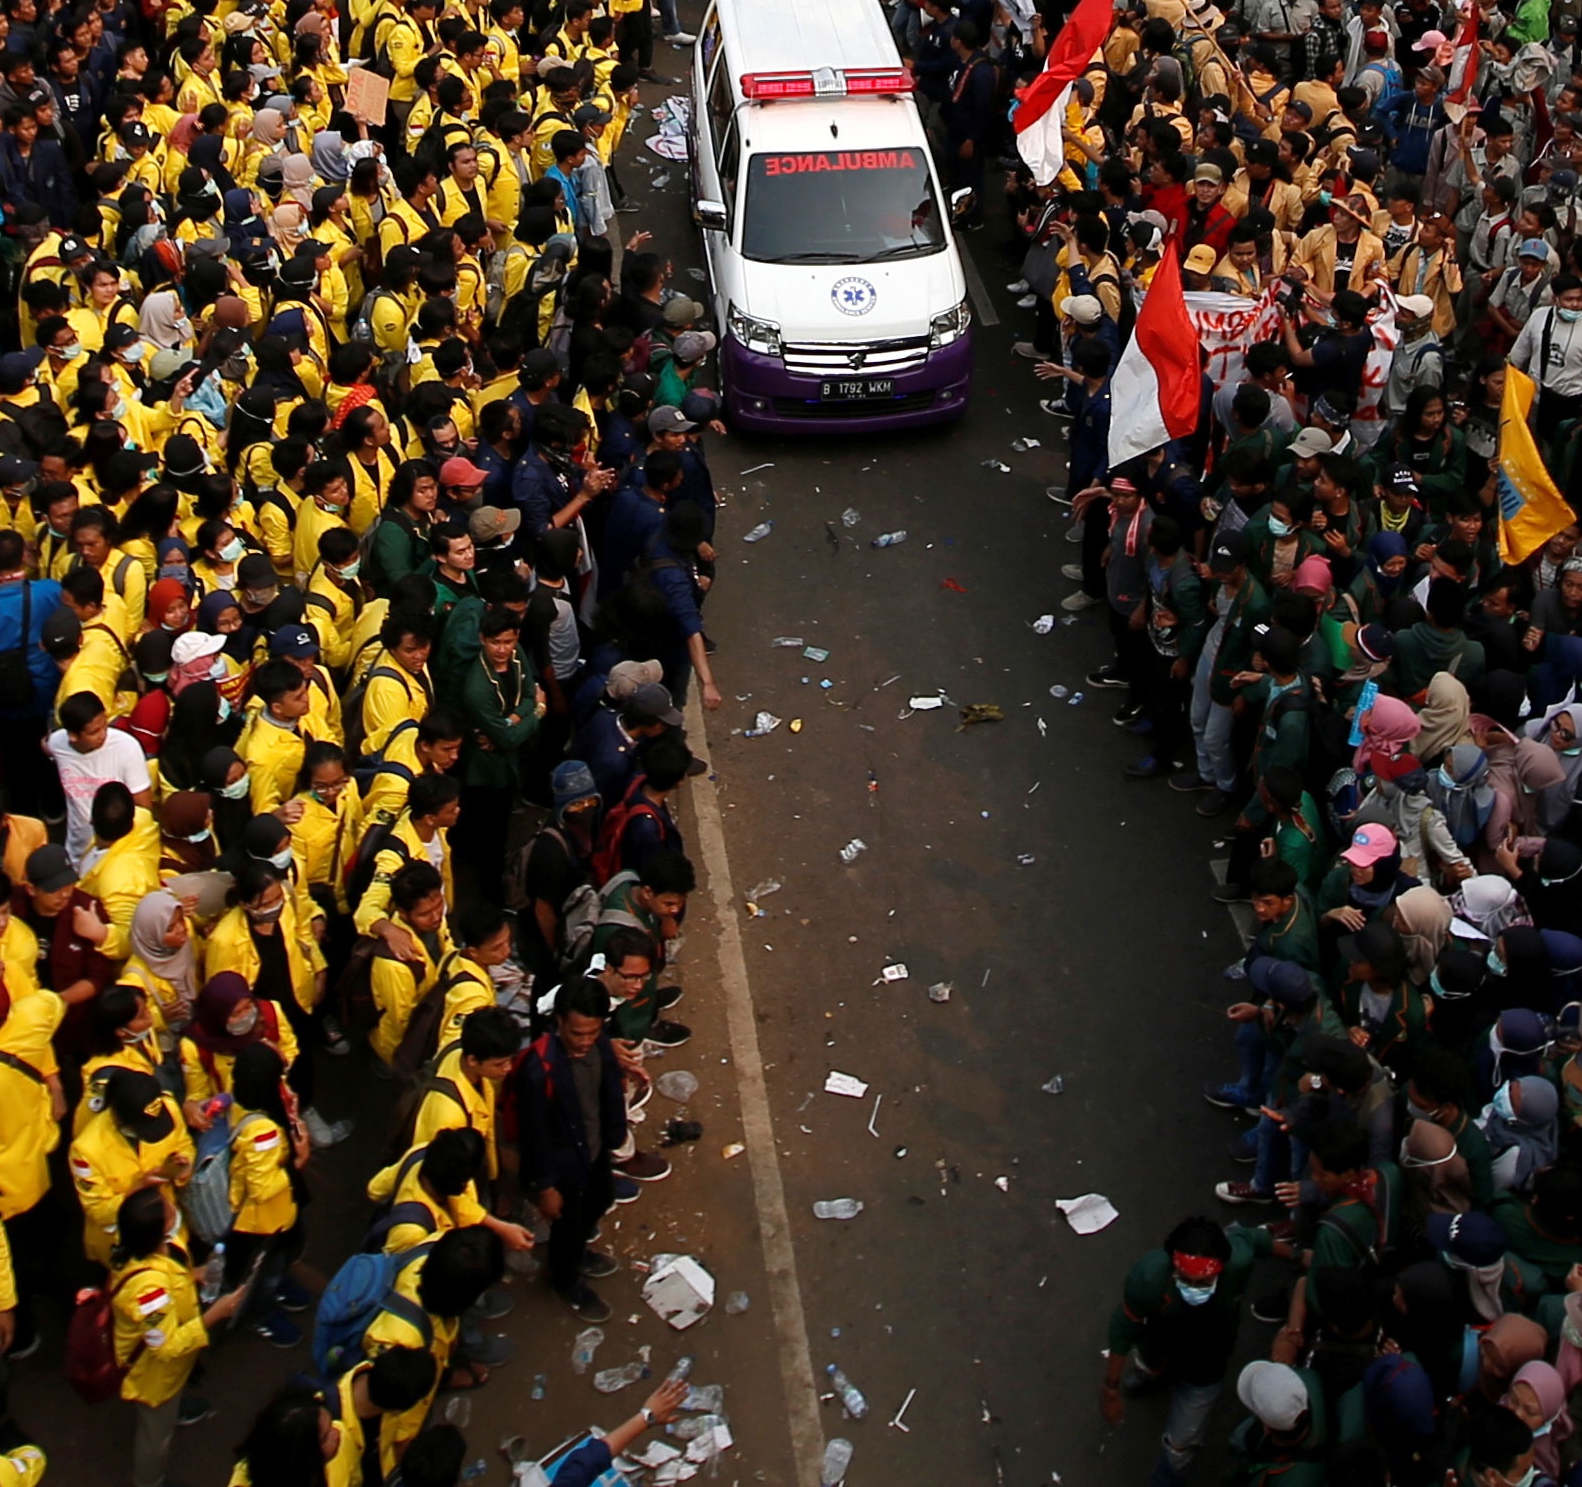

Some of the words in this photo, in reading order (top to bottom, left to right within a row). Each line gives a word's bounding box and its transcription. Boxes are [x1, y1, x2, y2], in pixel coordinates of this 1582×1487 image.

[823, 384, 831, 395] B
[839, 382, 863, 394] 1792
[868, 381, 891, 393] WKM
